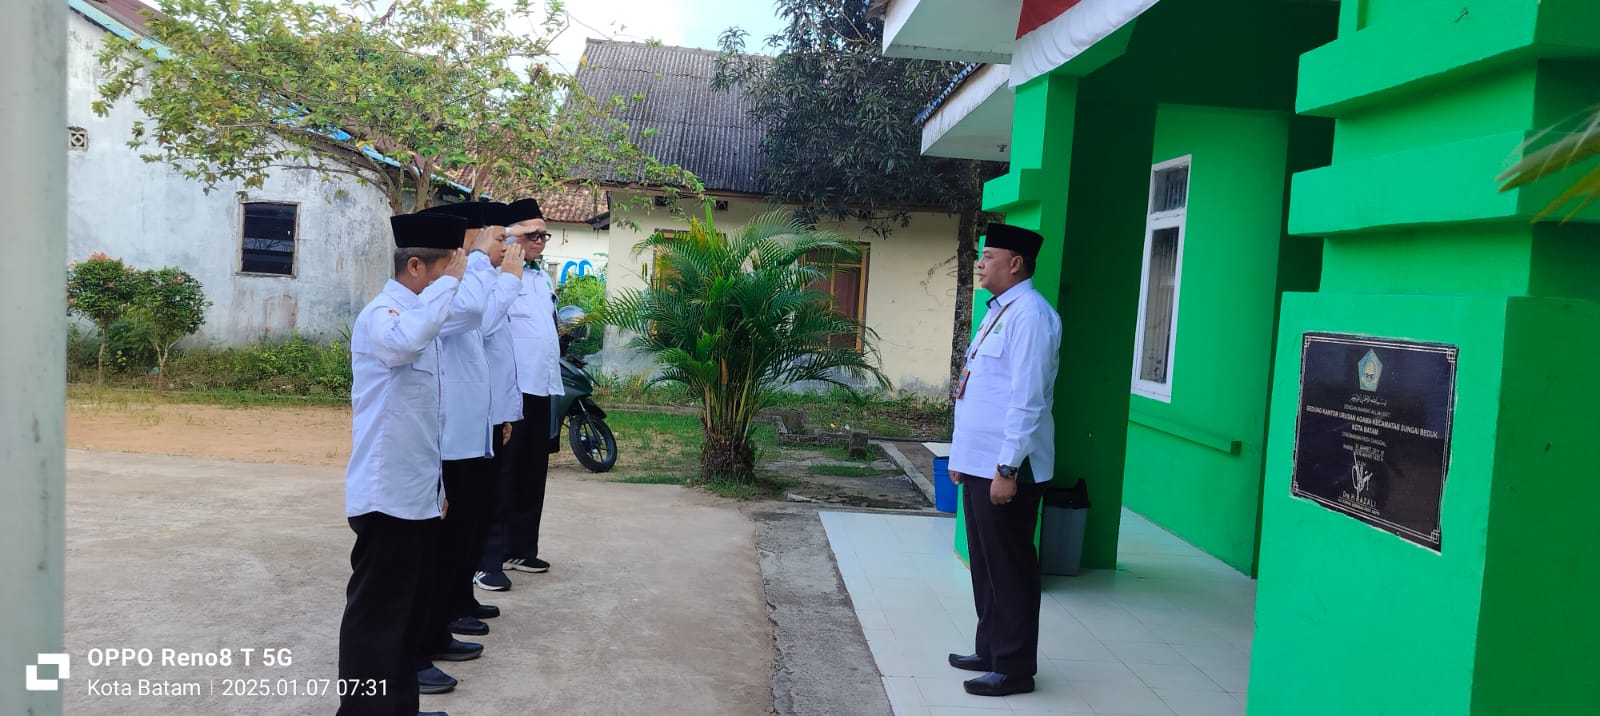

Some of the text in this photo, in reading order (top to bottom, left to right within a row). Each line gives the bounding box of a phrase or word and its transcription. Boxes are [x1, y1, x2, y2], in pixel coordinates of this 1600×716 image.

[1322, 408, 1339, 418] KANTOR
[1339, 412, 1355, 421] URUSAN
[1372, 418, 1400, 431] KECAMATAN
[1400, 424, 1419, 435] SUNGAI
[1419, 428, 1438, 439] BEDUK
[1351, 423, 1379, 435] KOTA BATAM
